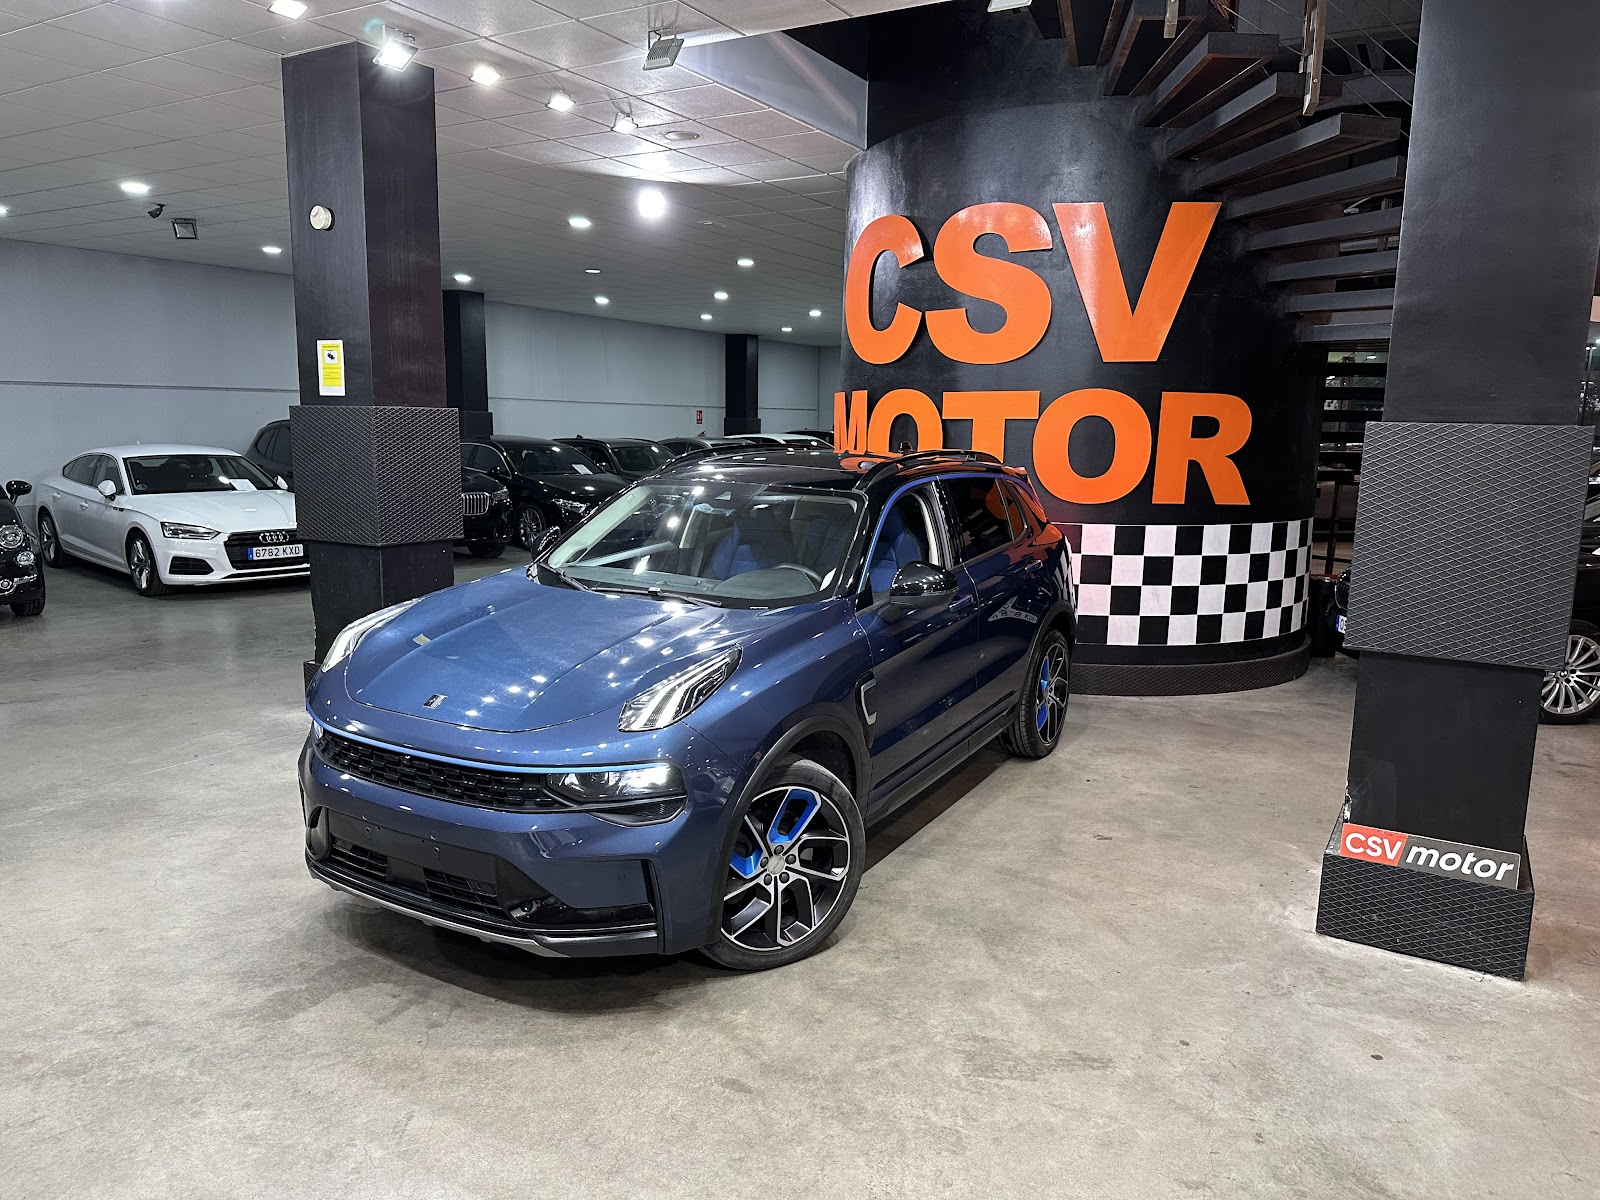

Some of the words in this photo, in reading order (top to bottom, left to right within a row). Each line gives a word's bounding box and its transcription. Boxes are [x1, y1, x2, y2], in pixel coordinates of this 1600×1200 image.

[845, 201, 1222, 364] CSV
[833, 388, 1252, 505] MOTOR
[255, 547, 280, 558] 6782
[282, 545, 300, 556] KXD
[1345, 832, 1402, 860] CSV
[1405, 845, 1515, 881] motor
